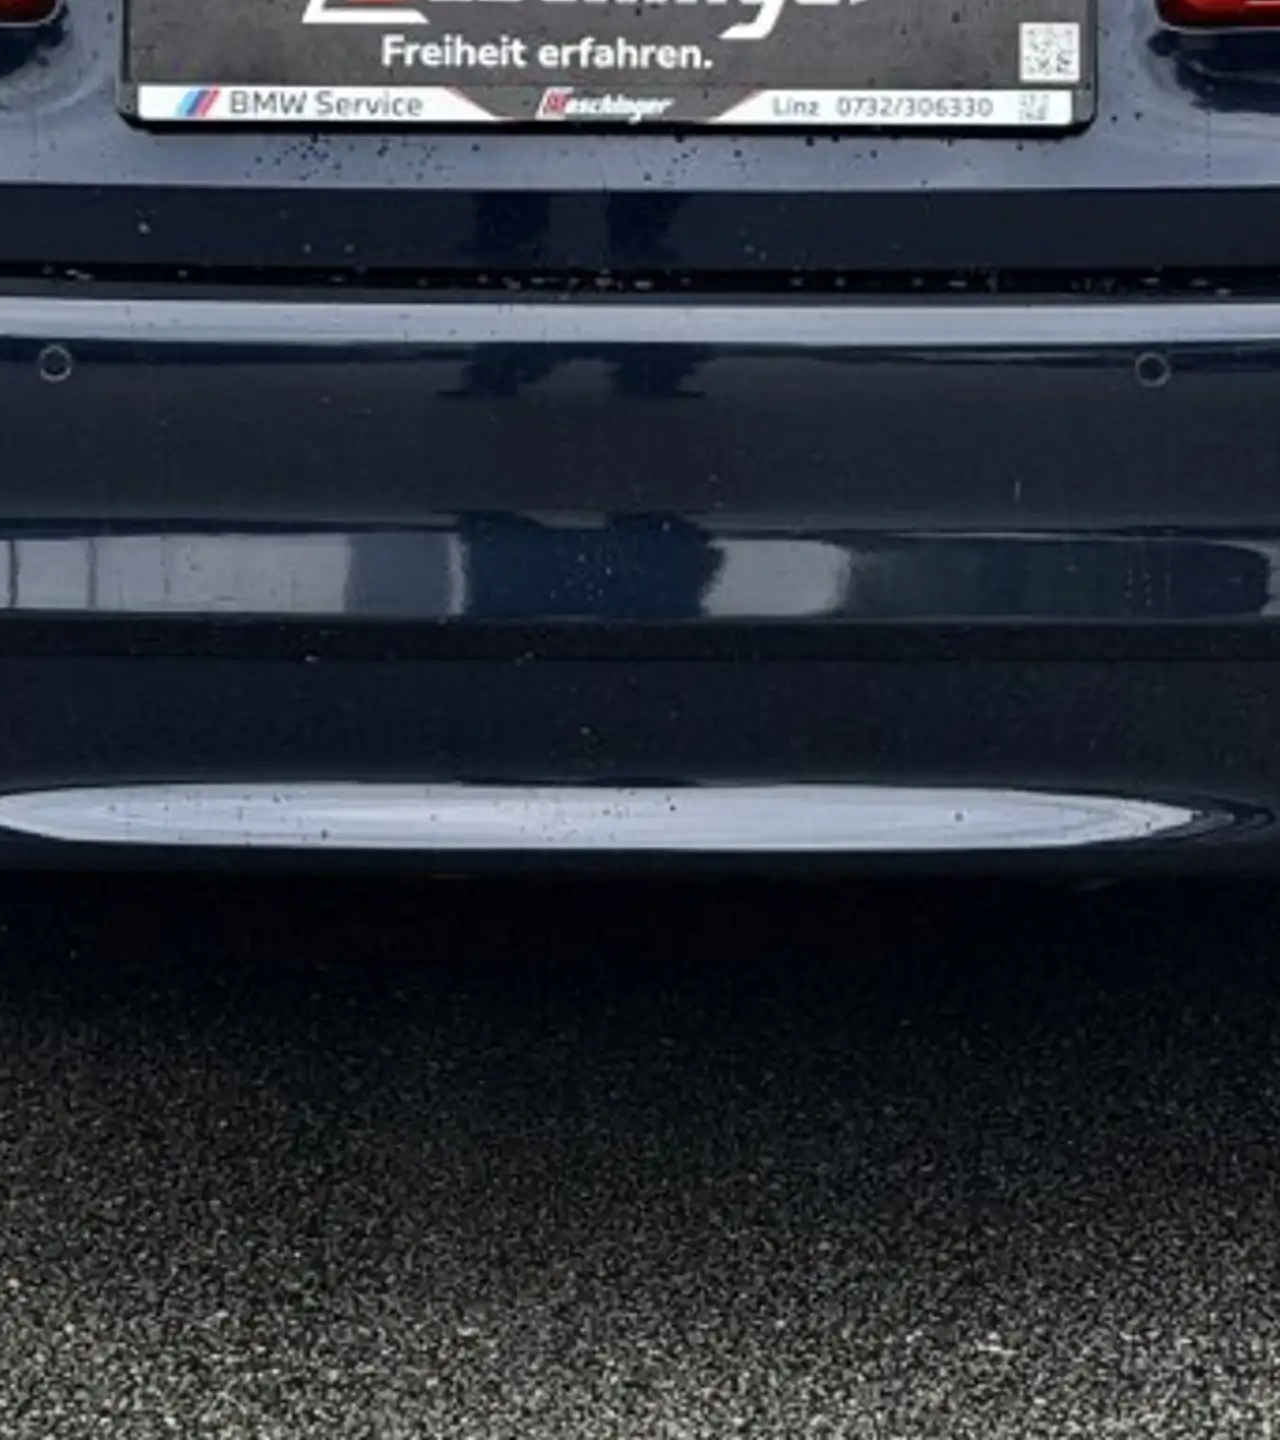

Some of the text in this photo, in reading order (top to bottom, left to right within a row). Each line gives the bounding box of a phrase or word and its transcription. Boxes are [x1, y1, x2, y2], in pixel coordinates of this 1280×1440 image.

[381, 34, 713, 70] Freiheit erfahren.
[230, 90, 424, 117] BMW Service
[773, 96, 994, 118] Linz 0732/306330
